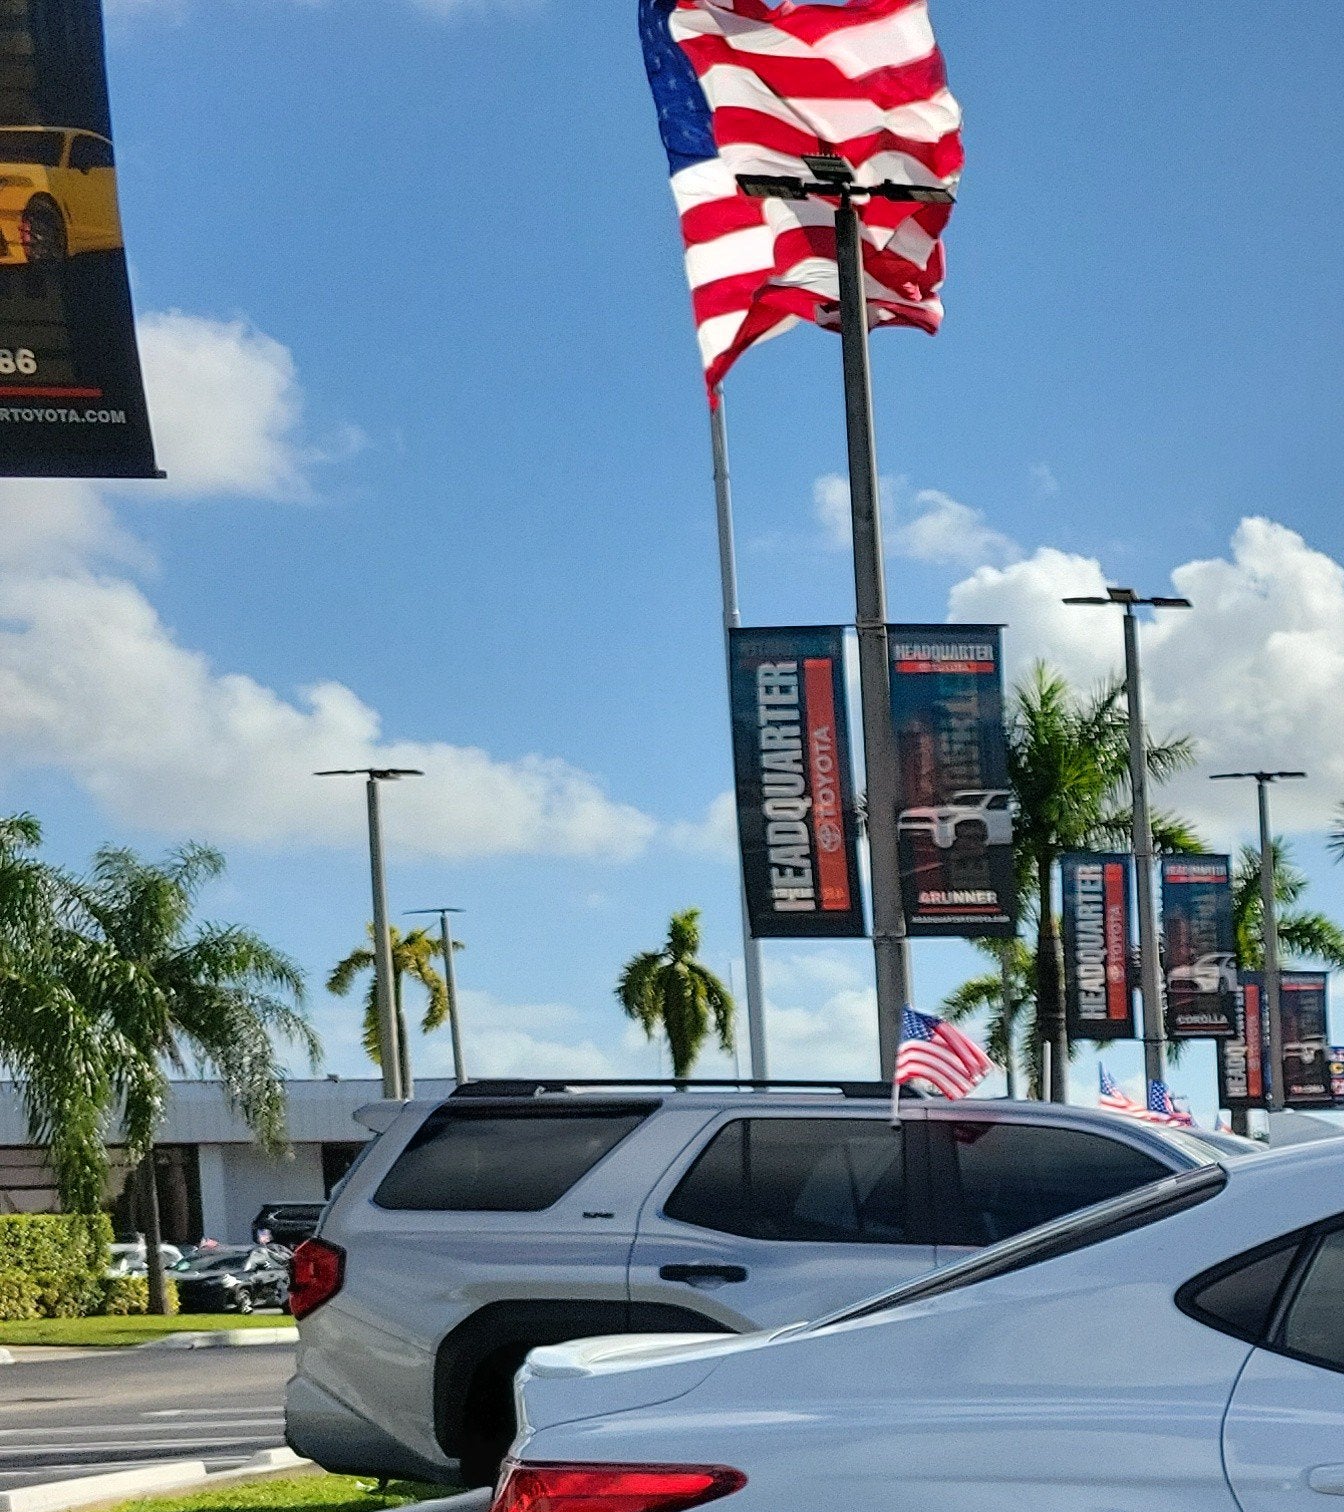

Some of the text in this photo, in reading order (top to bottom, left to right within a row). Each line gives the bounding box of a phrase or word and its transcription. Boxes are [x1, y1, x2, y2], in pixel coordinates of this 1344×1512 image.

[894, 642, 995, 662] HEADQUARTER
[756, 659, 816, 913] HEADQUARTER
[813, 726, 838, 818] TOYOTA
[1075, 864, 1109, 1020] HEADQUARTER
